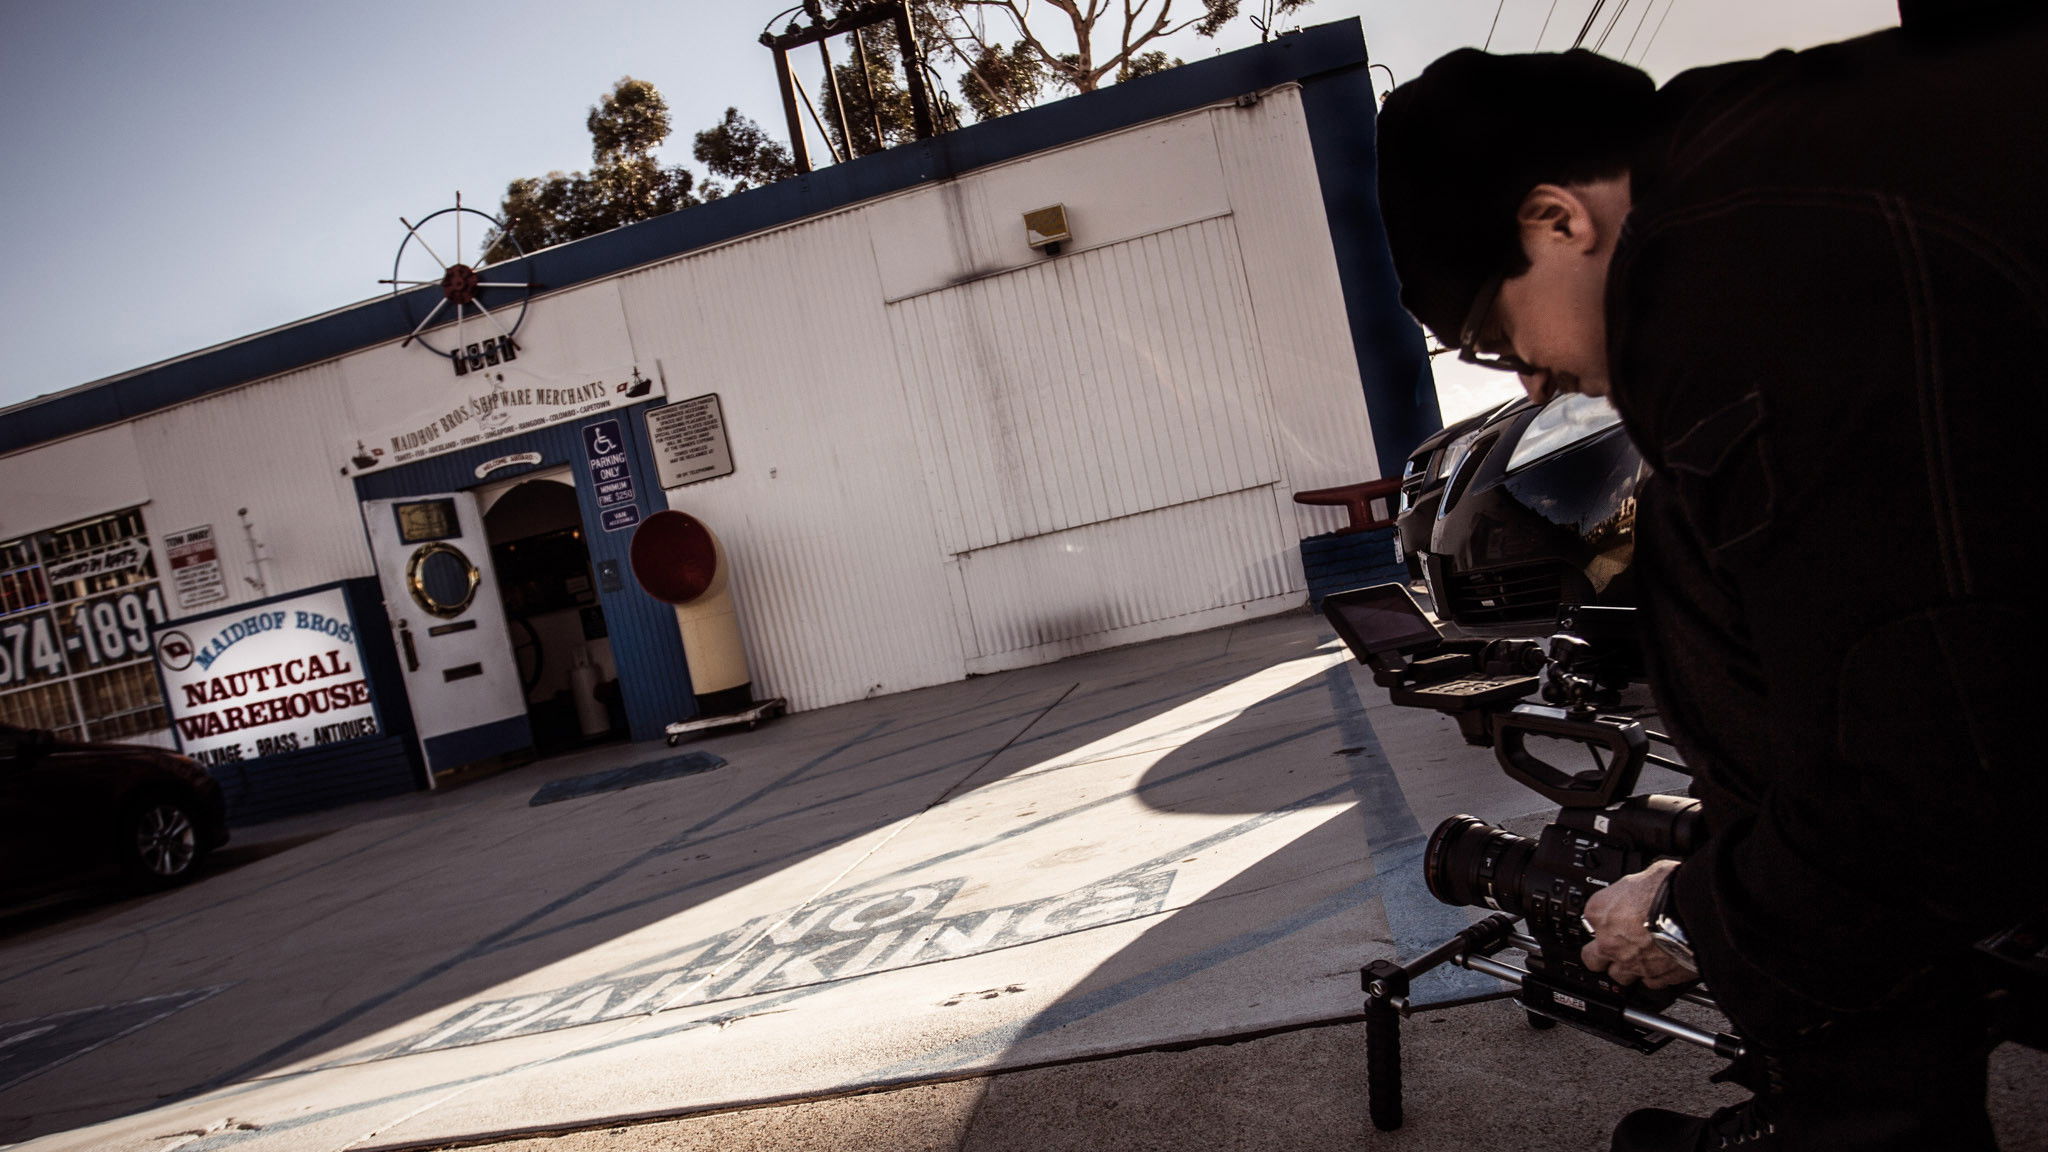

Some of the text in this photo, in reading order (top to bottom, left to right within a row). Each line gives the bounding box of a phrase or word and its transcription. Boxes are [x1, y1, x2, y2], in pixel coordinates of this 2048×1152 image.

[391, 422, 440, 452] MAIDHOF
[440, 406, 474, 433] BROS.
[536, 381, 606, 406] MERCHANTS
[485, 426, 515, 440] SINGAPORE
[549, 410, 576, 422] COLOMBO
[580, 401, 611, 413] CAPETOWN
[483, 458, 508, 471] WELCOME
[590, 452, 625, 470] PARKING
[599, 466, 620, 480] ONLY
[598, 488, 633, 504] FINE $250
[599, 480, 627, 494] MINIMUM
[613, 511, 626, 519] VAN
[195, 611, 354, 671] MAIDHOF BROS.
[182, 650, 351, 707] NAUTICAL
[175, 679, 374, 741] WAREHOUSE
[257, 733, 299, 757] BRASS
[314, 717, 377, 745] ANTIQUES
[710, 884, 941, 957] NO
[406, 884, 1142, 1051] PARKING
